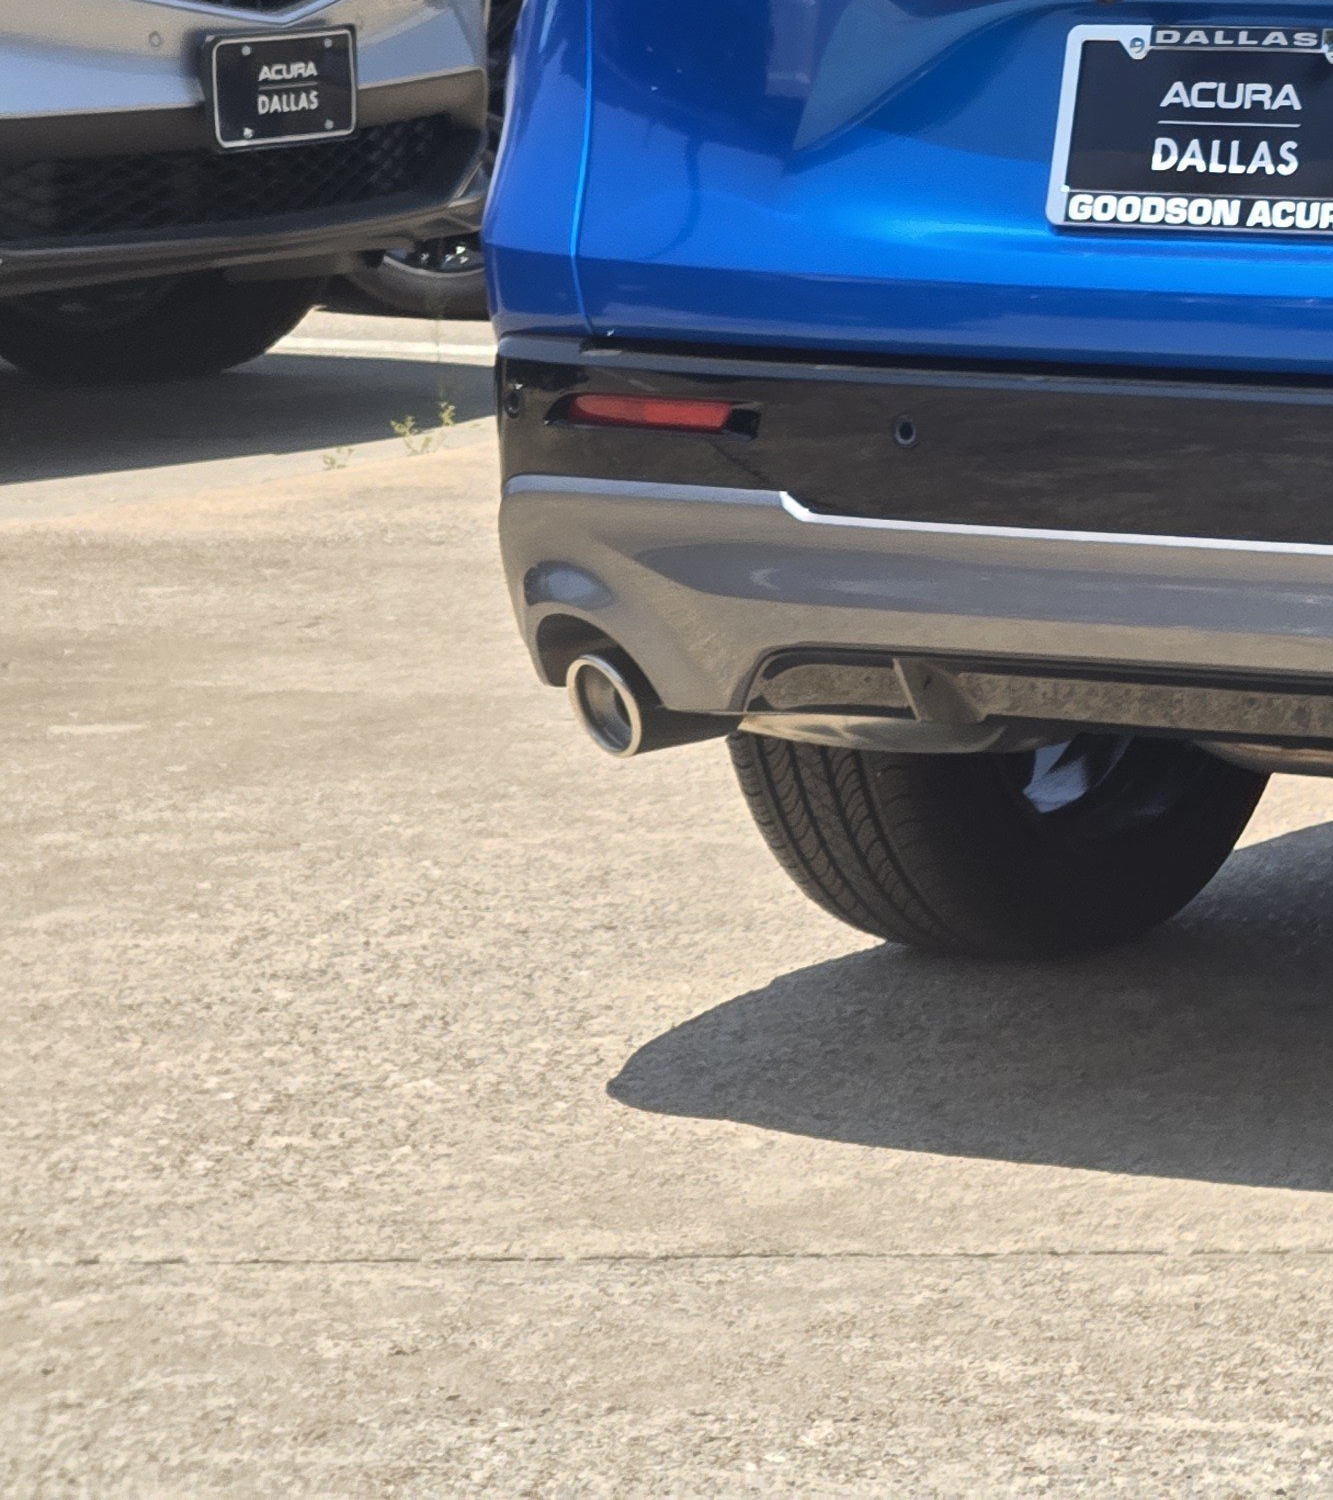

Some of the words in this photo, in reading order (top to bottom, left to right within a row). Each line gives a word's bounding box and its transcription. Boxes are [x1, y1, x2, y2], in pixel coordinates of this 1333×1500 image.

[1155, 29, 1320, 48] DALLAS
[258, 61, 318, 82] ACURA
[257, 90, 319, 115] DALLAS
[1159, 81, 1302, 111] ACURA
[1151, 136, 1299, 176] DALLAS
[1067, 194, 1240, 227] GOODSON
